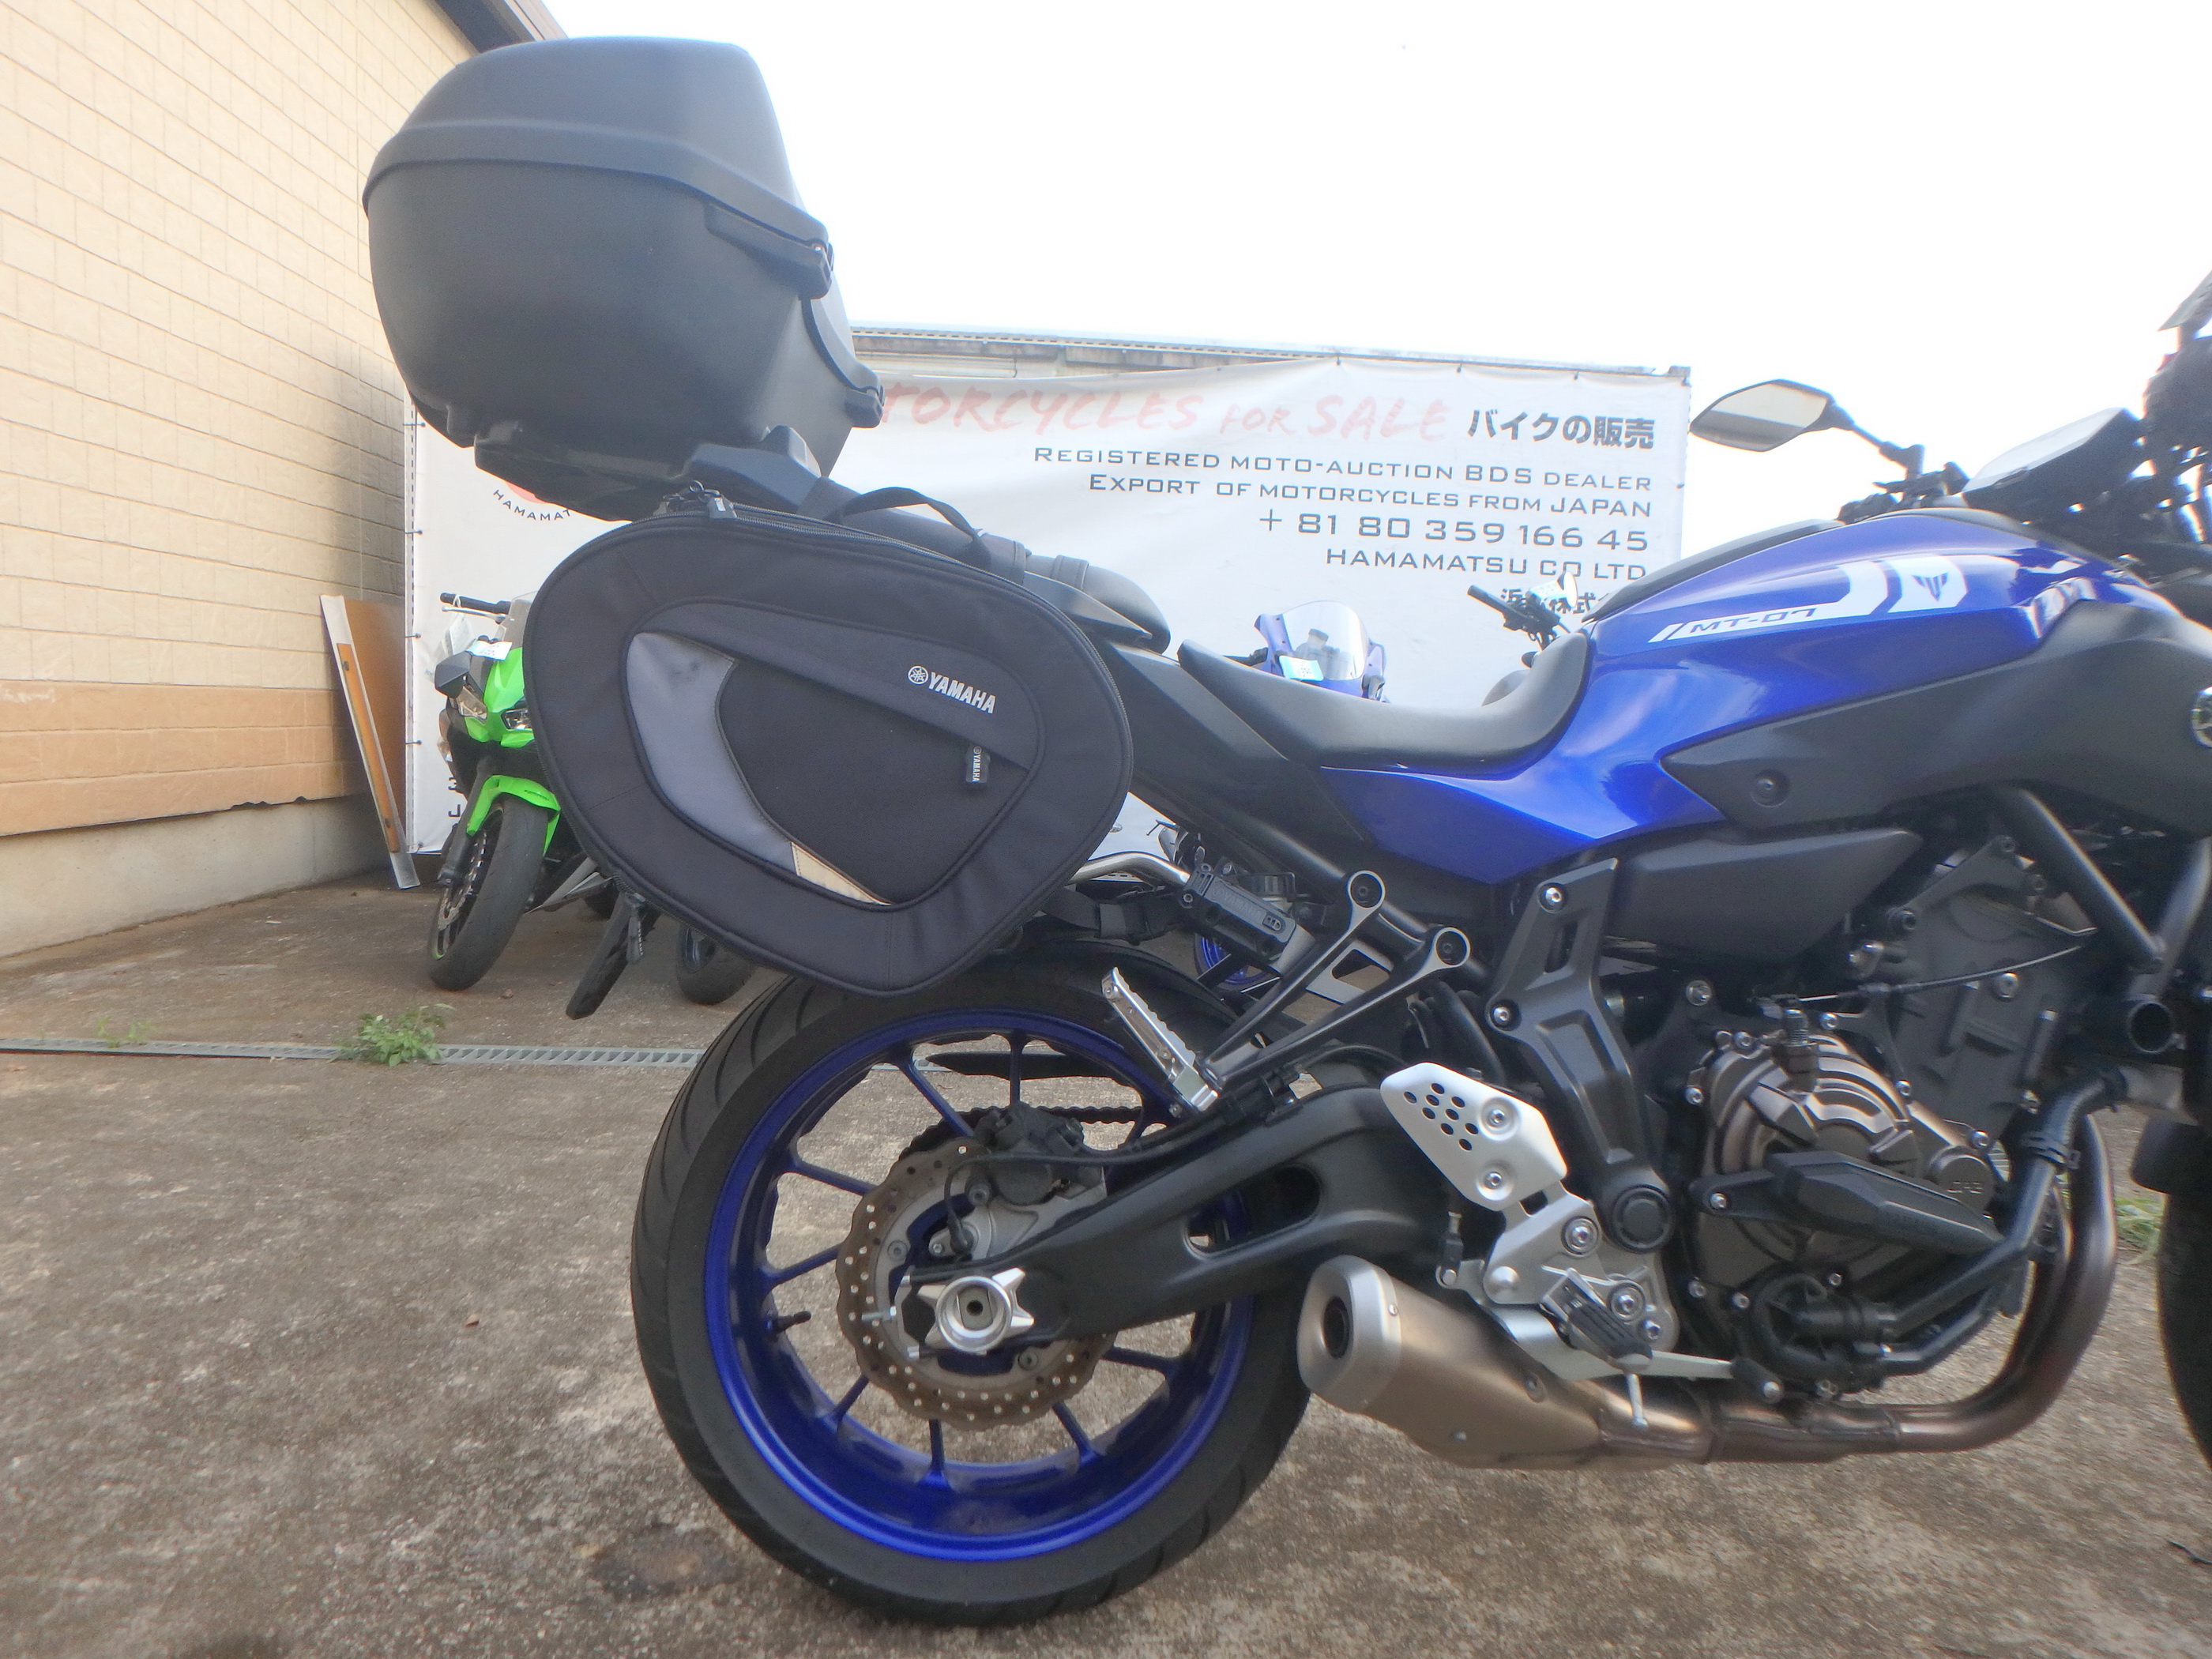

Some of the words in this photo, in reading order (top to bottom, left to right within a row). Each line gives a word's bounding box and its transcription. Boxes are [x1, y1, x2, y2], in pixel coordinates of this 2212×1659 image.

[881, 382, 1203, 435] TORCYCLES
[1220, 404, 1296, 436] FOR
[1307, 394, 1450, 441] SALE
[1467, 409, 1655, 450] バイクの販売
[1034, 447, 1220, 468] REGISTERED
[1230, 455, 1453, 480] MOTO-AUCTION
[1465, 465, 1532, 484] BDS
[1544, 472, 1651, 491] DEALER
[493, 489, 571, 521] HAMAMAT
[1089, 474, 1200, 495] EXPORT
[1217, 482, 1251, 496] OF
[1259, 483, 1459, 507] MOTORCYCLES
[1469, 495, 1540, 512] FROM
[1550, 497, 1651, 517] JAPAN
[1298, 513, 1336, 535] 81
[1358, 516, 1410, 538] 80
[1425, 519, 1504, 544] 359
[1518, 525, 1583, 548] 166
[1597, 529, 1648, 551] 45
[1326, 547, 1526, 574] HAMAMATSU
[1540, 559, 1581, 577] CO
[1594, 562, 1646, 581] LTD
[1689, 608, 1816, 634] MT-07
[928, 672, 996, 714] YAMAHA
[972, 754, 981, 782] YAMAHA
